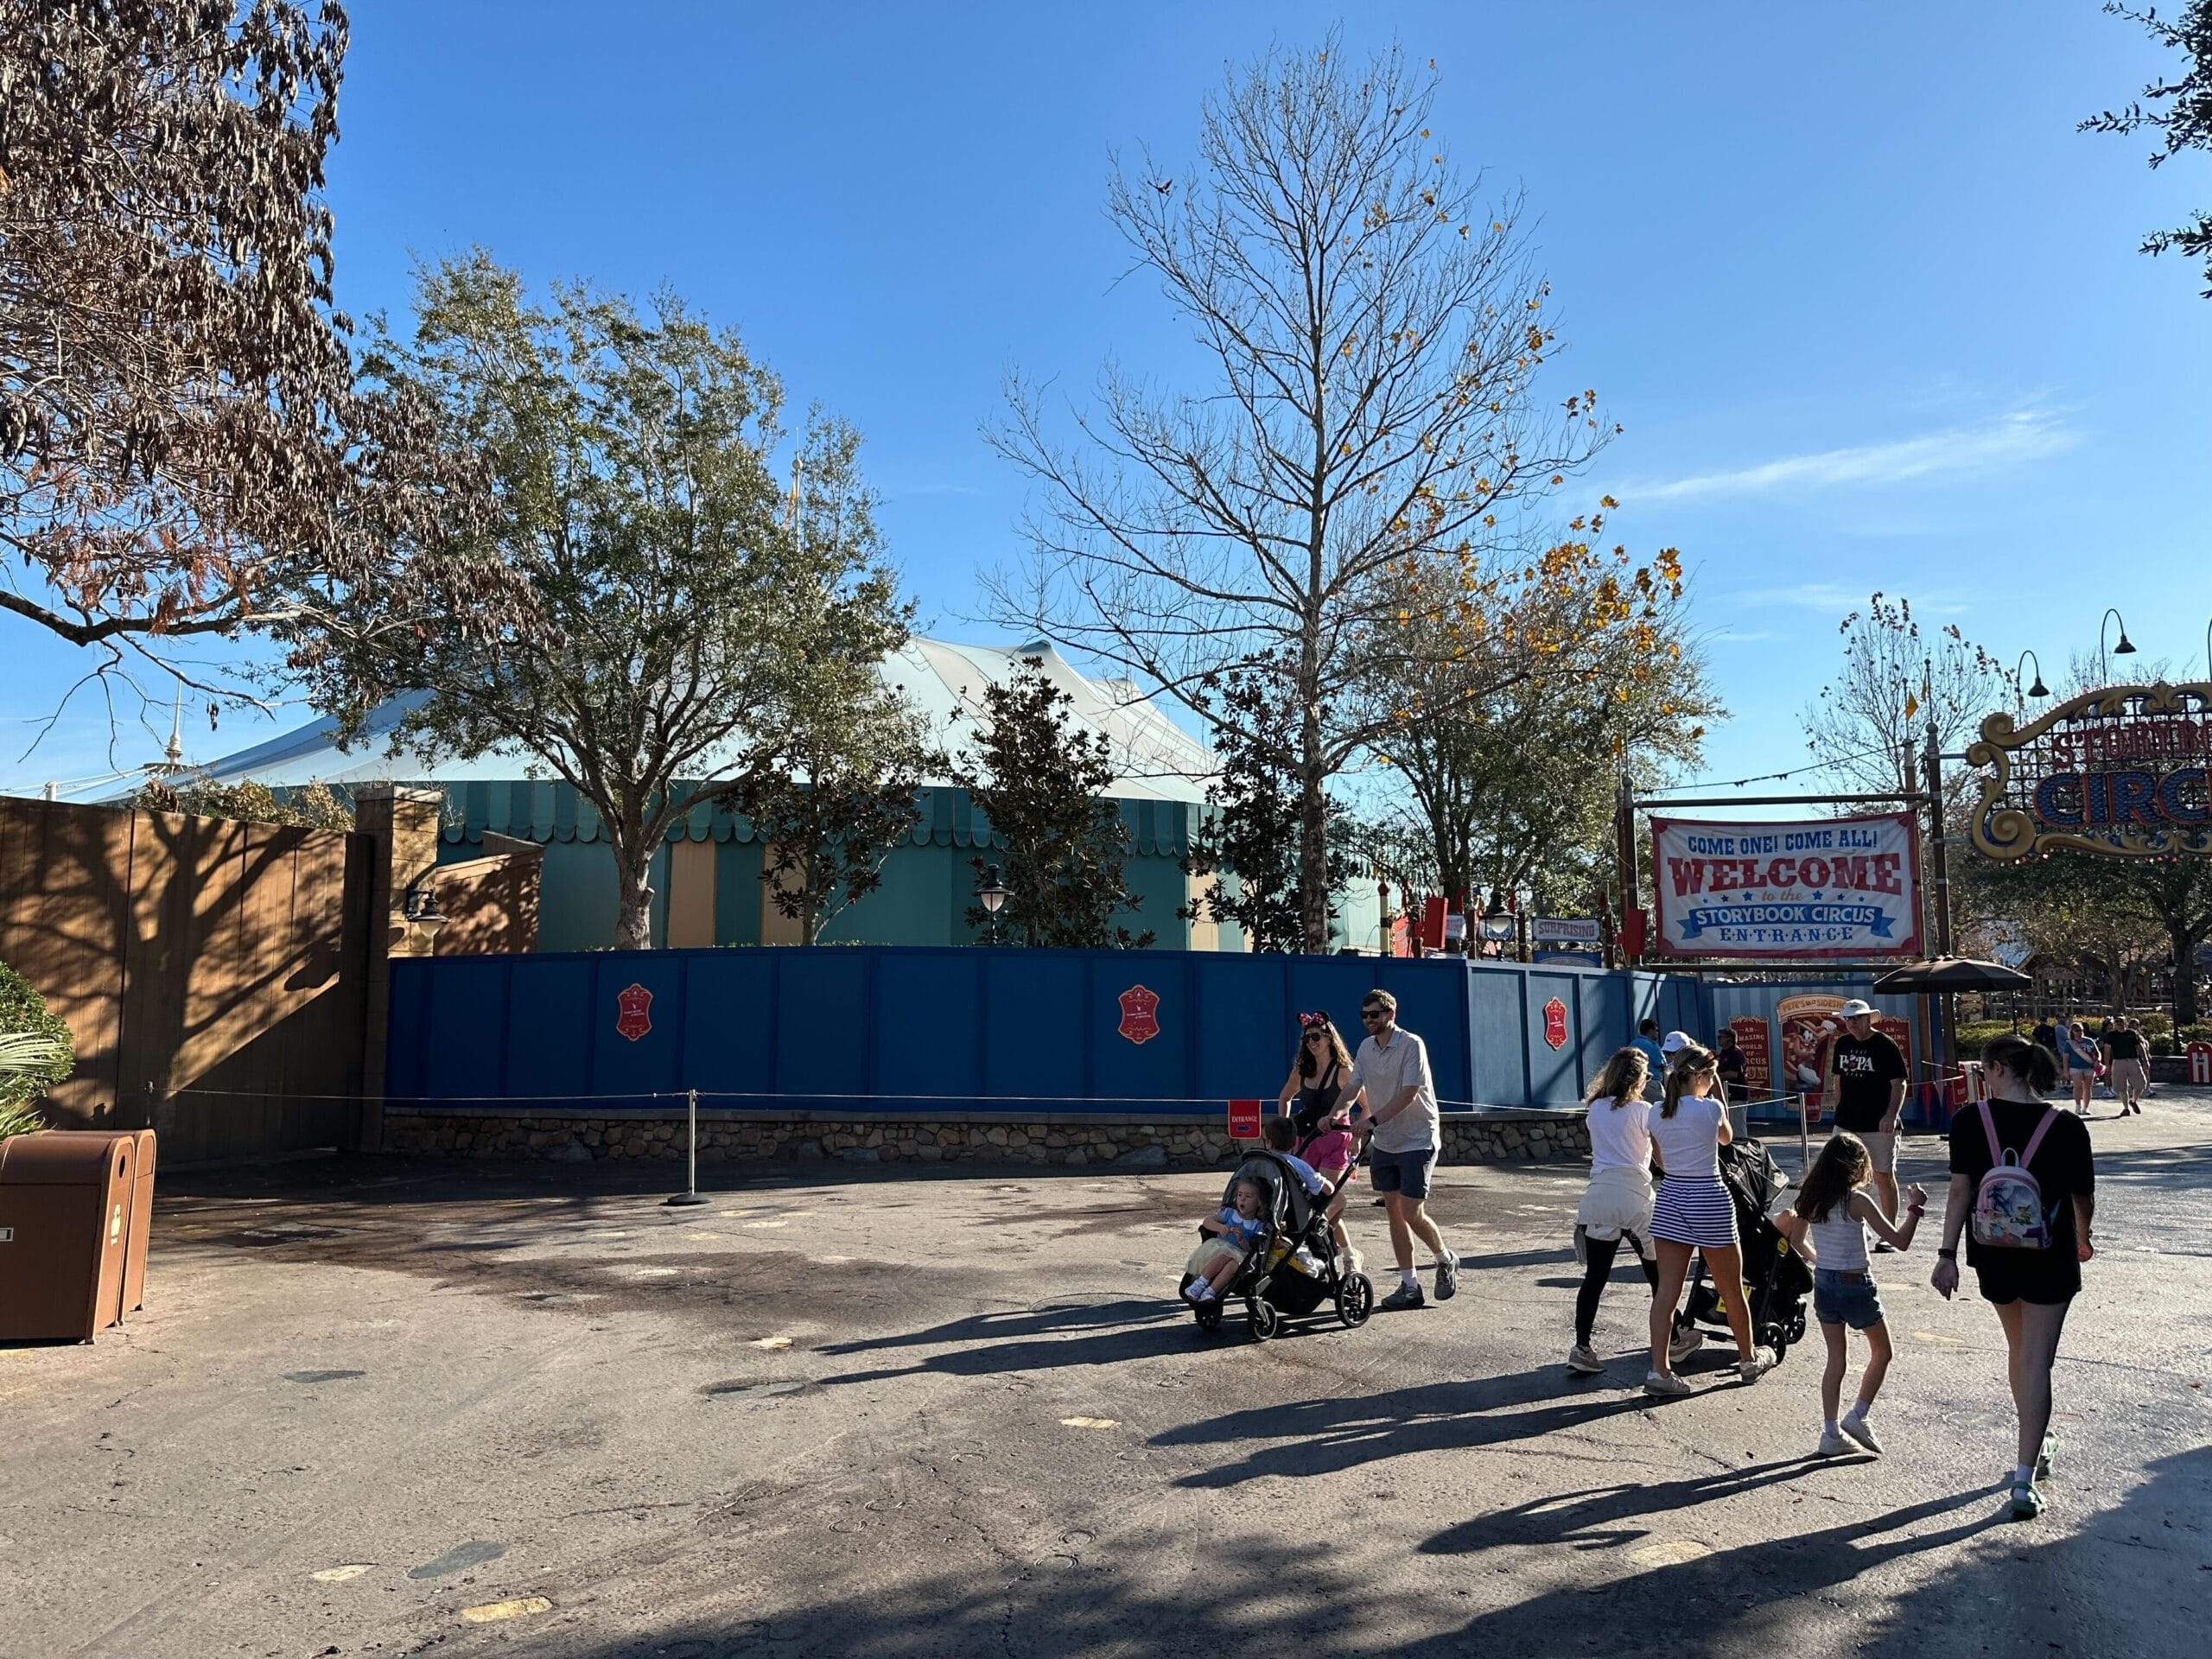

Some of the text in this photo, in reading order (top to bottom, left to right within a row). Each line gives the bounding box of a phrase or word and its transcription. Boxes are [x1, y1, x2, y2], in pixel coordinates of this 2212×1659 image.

[1688, 829, 1878, 855] COME ONE! COME ALL!
[1668, 852, 1902, 898] WELCOME
[1761, 887, 1804, 902] to the
[1695, 906, 1876, 925] STORYBOOK CIRCUS
[1538, 920, 1595, 938] SURPRISING
[1816, 998, 1845, 1010] SIDESH
[1747, 1065, 1768, 1079] UN
